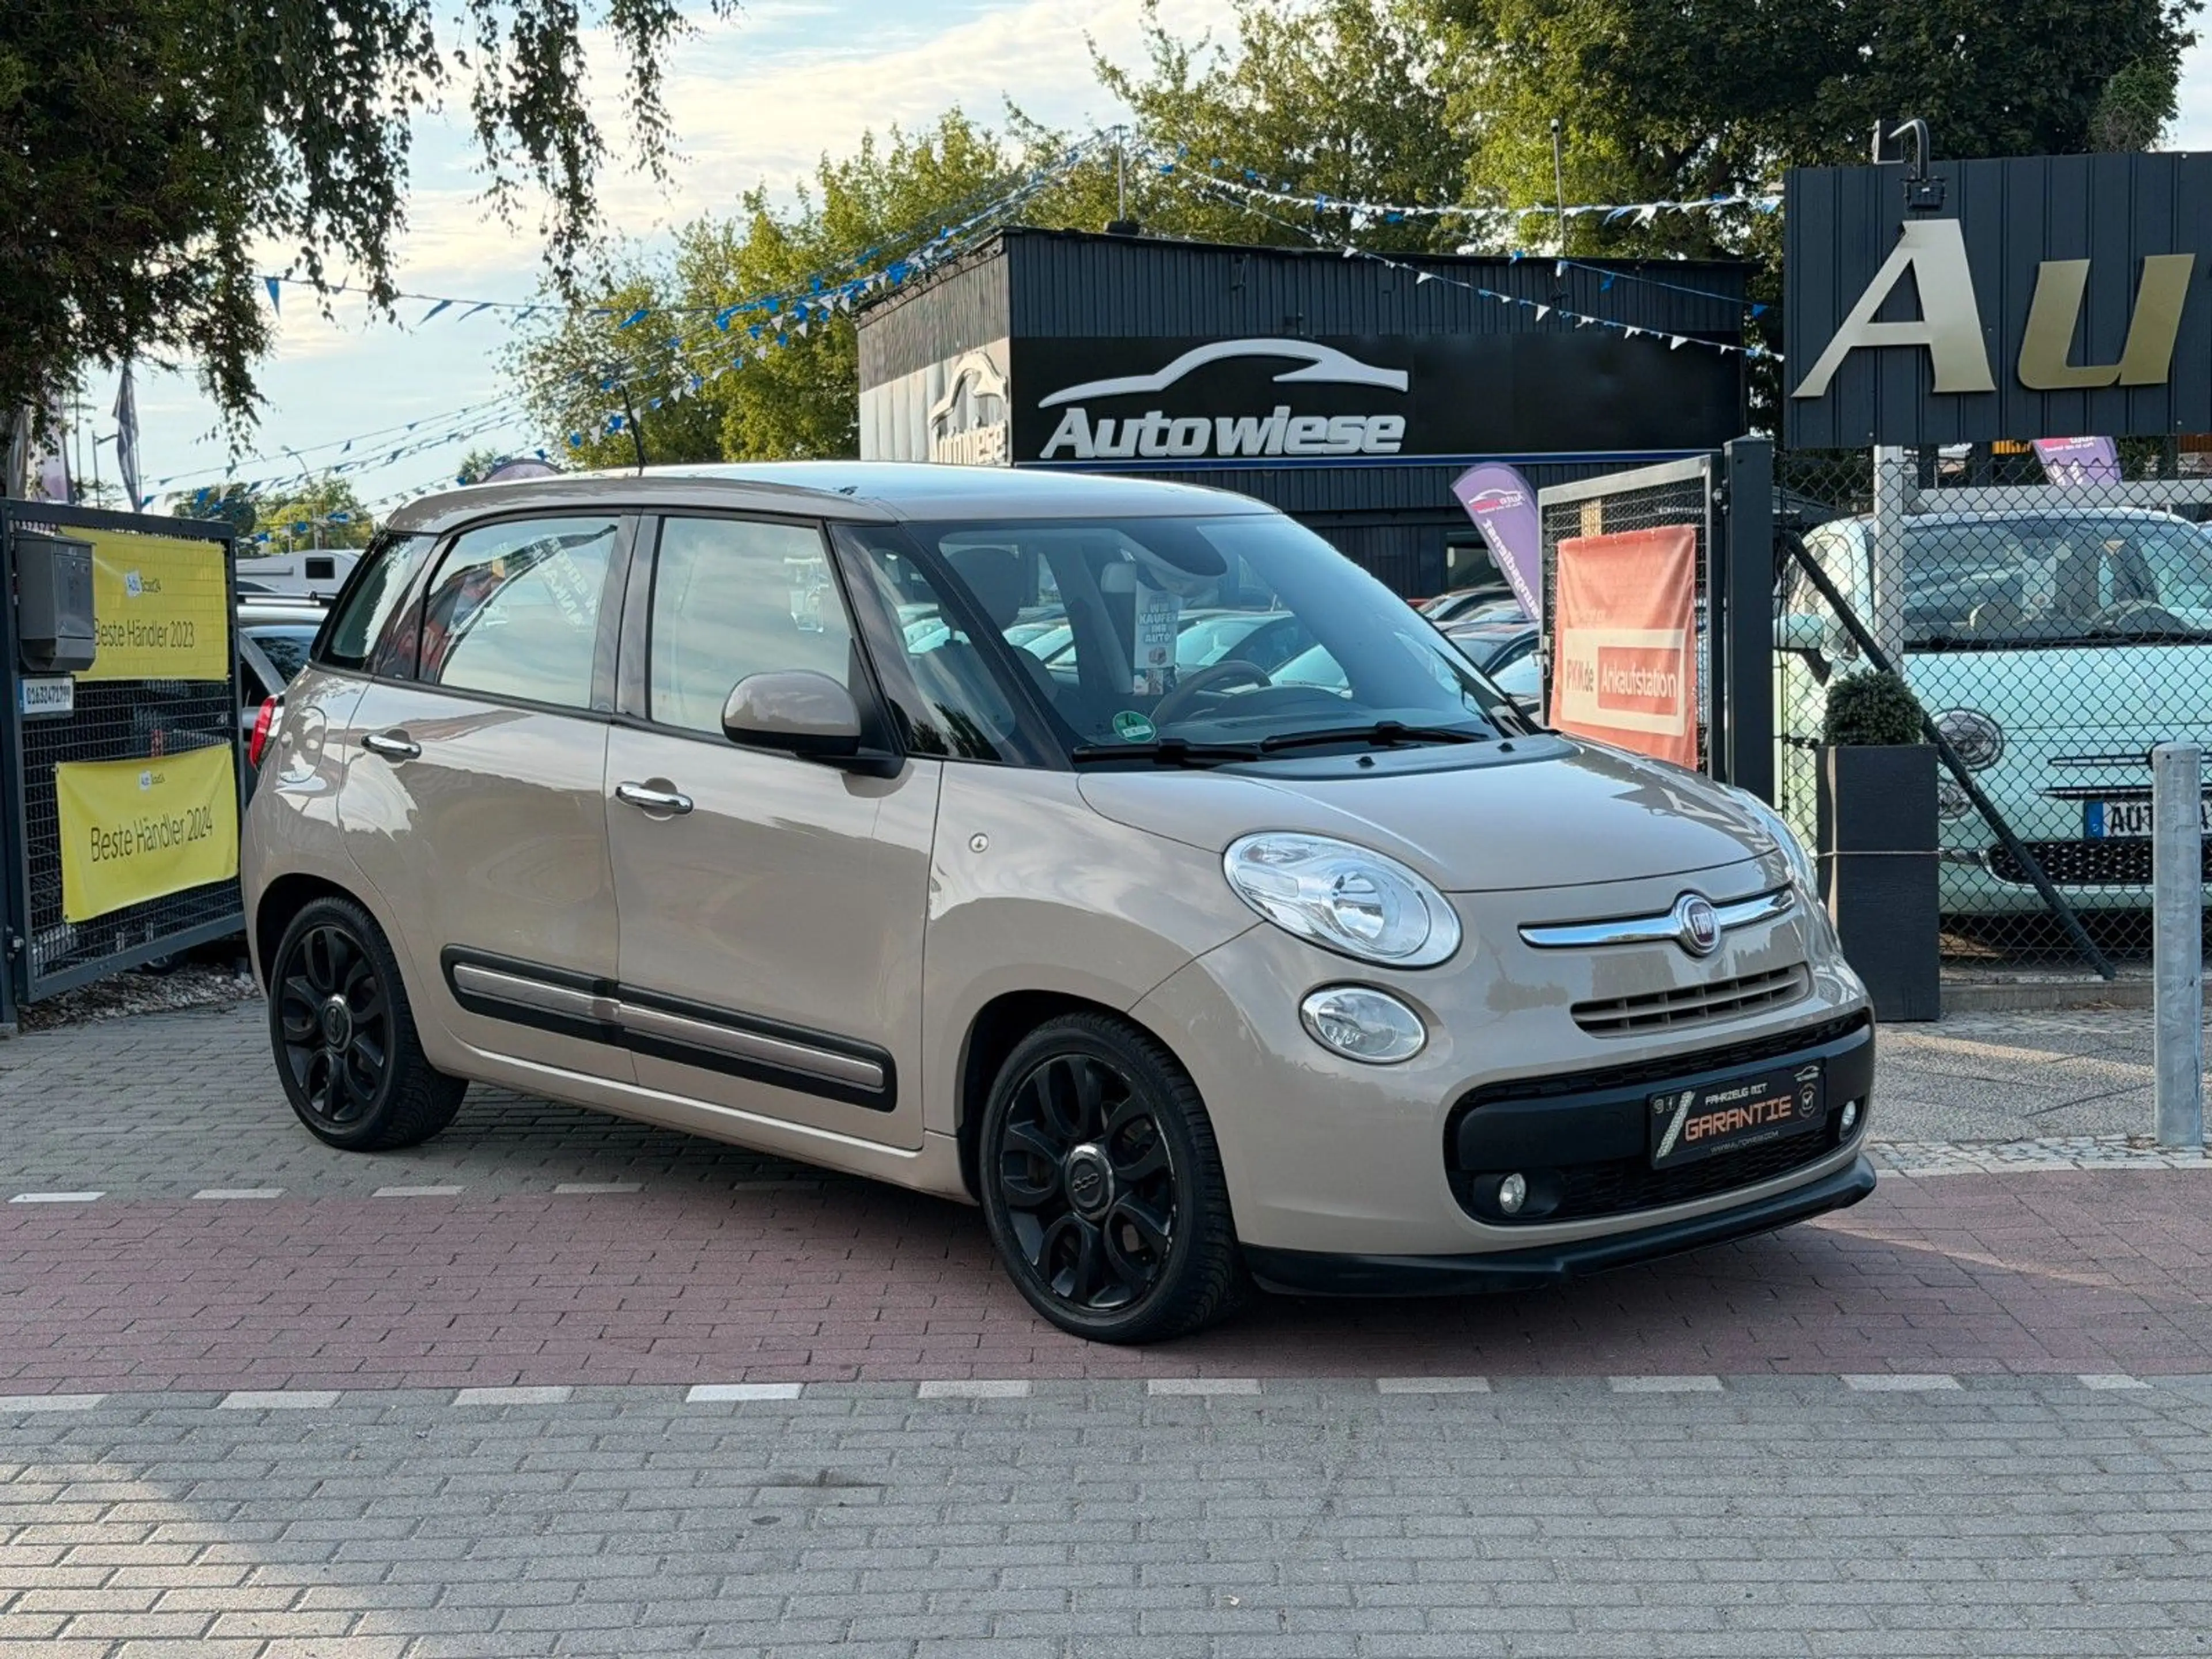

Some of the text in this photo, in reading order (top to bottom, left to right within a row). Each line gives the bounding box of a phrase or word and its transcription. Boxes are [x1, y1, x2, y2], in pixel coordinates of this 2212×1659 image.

[1039, 405, 1406, 459] Autowiese
[94, 618, 195, 649] Beste Händler 2023
[1599, 660, 1677, 698] Ankaufstation
[90, 806, 213, 862] Beste Händler 2024
[1685, 1094, 1791, 1142] GARANTIE
